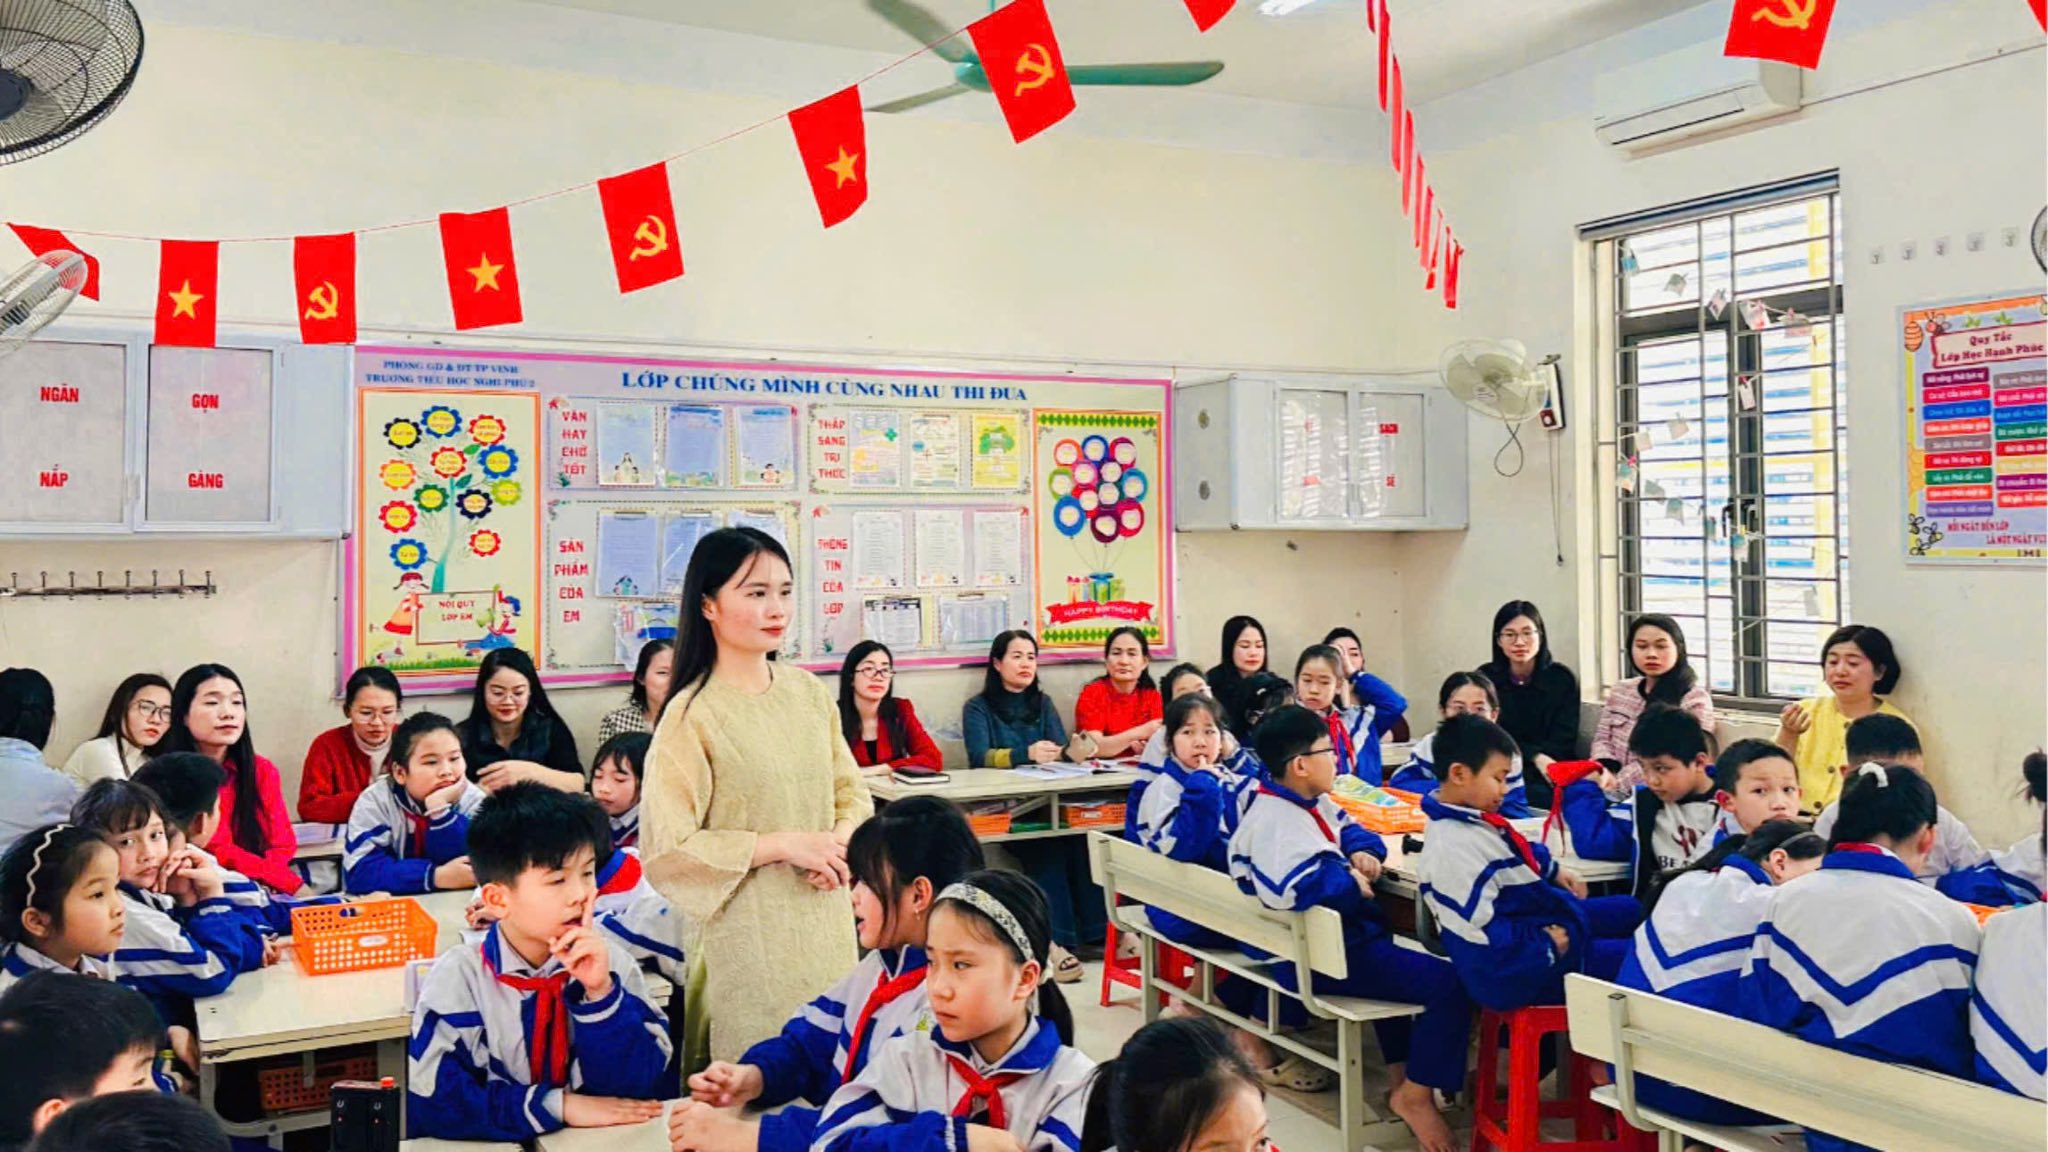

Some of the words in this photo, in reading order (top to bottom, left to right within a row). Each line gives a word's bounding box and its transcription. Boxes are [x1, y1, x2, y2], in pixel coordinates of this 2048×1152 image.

[40, 383, 80, 403] NGĂN
[621, 370, 669, 389] LỚP
[674, 373, 756, 391] CHÚNG
[762, 376, 820, 394] MÌNH
[826, 379, 884, 396] CÙNG
[890, 382, 945, 398] NHAU
[952, 385, 984, 399] THI
[989, 385, 1027, 400] ĐUA
[191, 394, 219, 413] GỌN
[562, 429, 587, 440] HAY
[40, 463, 68, 488] NẮP
[188, 469, 224, 489] GÀNG
[825, 559, 842, 572] TIN
[563, 611, 580, 623] EM
